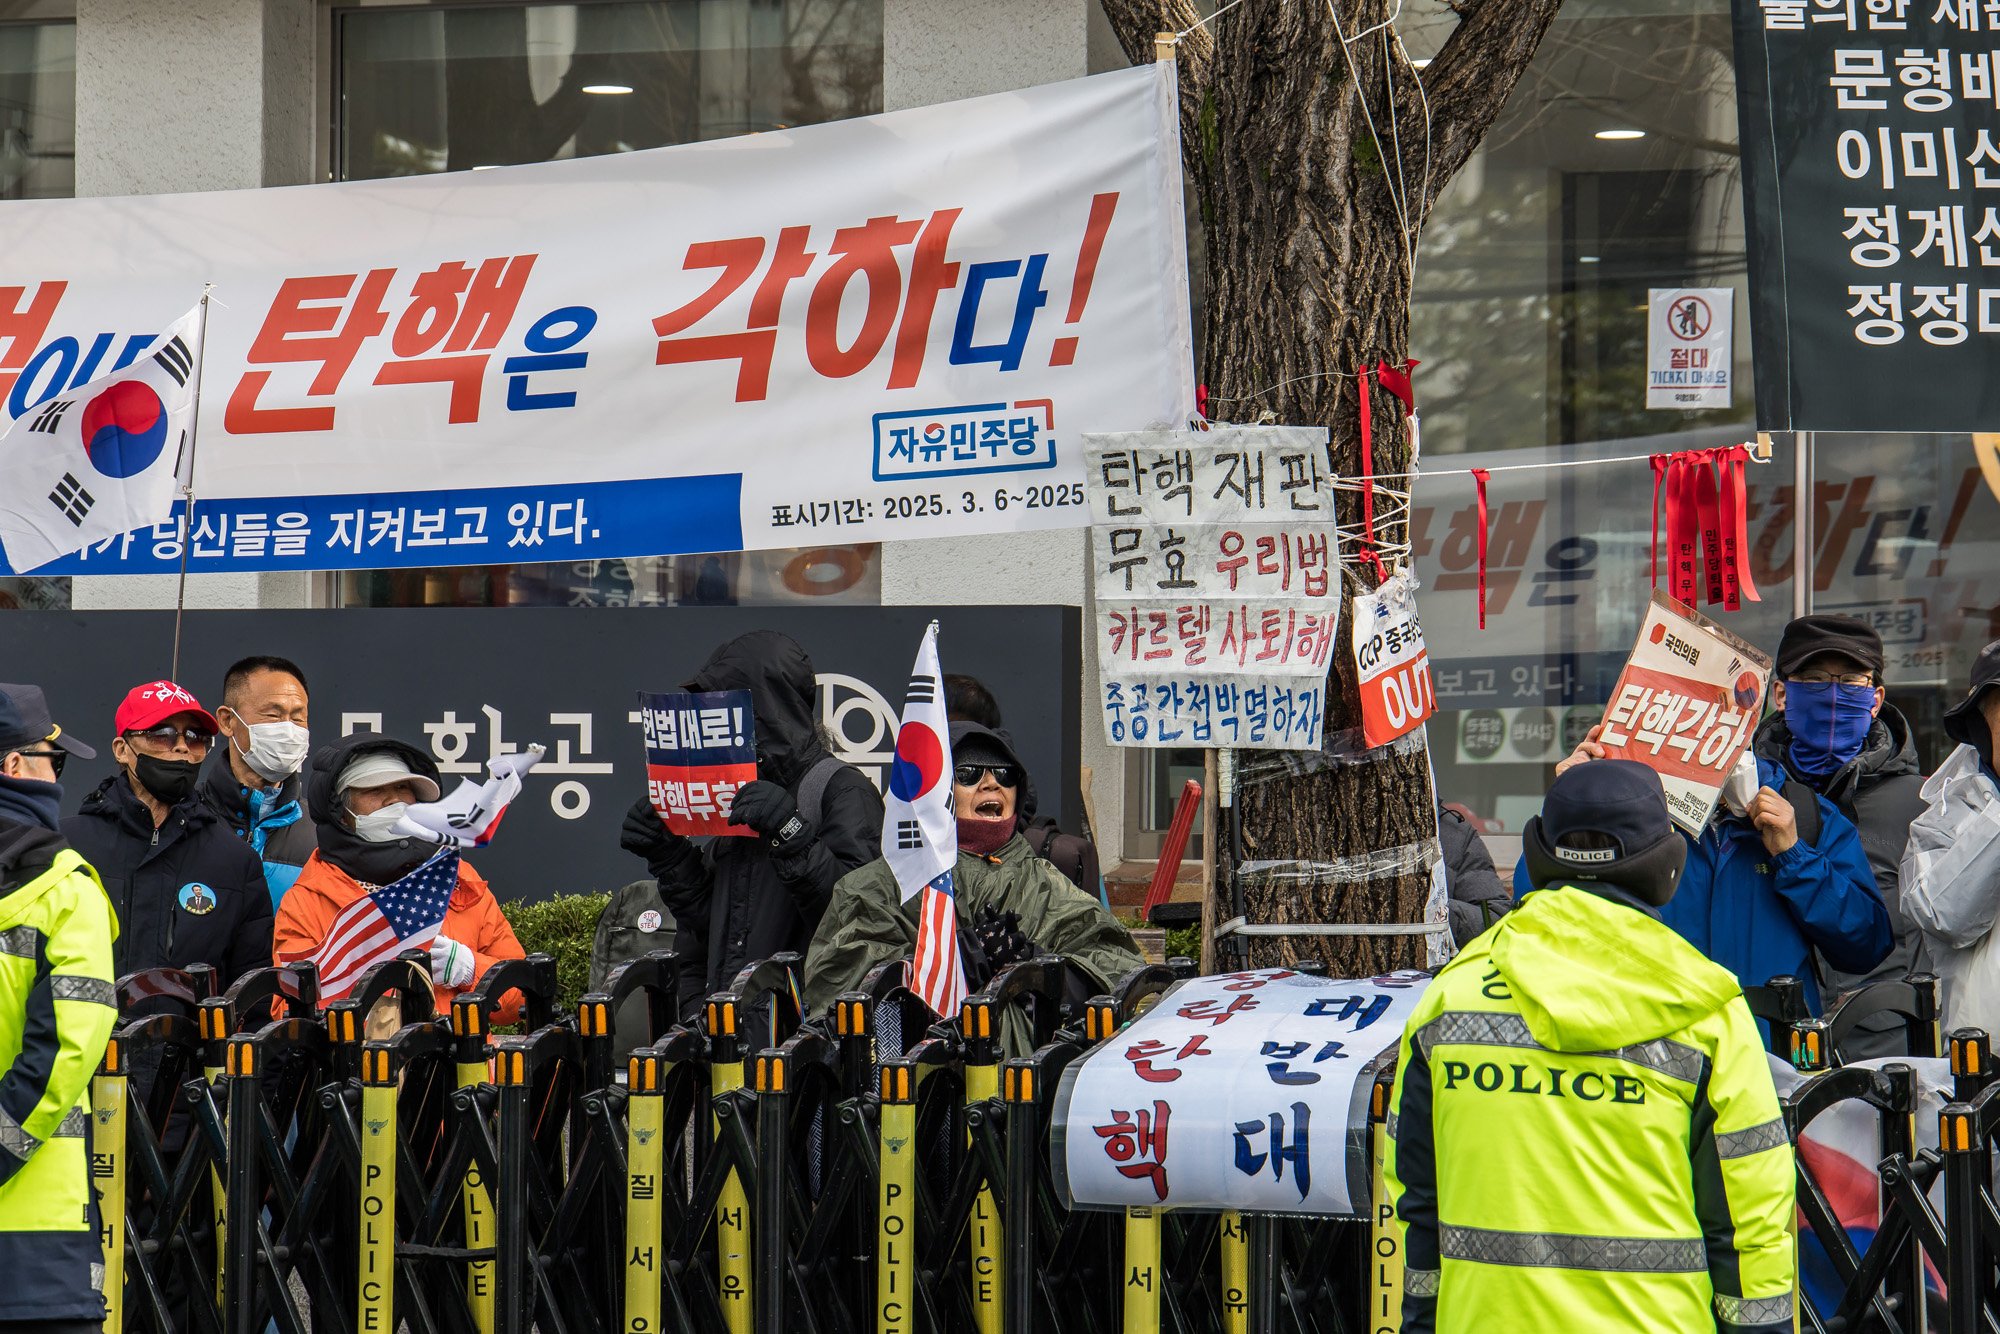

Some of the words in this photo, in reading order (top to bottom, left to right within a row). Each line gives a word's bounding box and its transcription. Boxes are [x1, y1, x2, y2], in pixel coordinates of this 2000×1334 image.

[224, 253, 598, 435] 탄핵은
[652, 192, 1120, 403] 각하다!
[1650, 371, 1687, 384] 기대지
[1670, 348, 1708, 369] 절대
[888, 415, 1040, 463] 자유민주당
[152, 511, 311, 560] 당신들을
[326, 506, 488, 556] 지켜보고
[507, 499, 601, 547] 있다.
[771, 499, 874, 528] 표시기간:
[883, 493, 953, 519] 2025.
[961, 491, 984, 514] 3.
[1108, 528, 1198, 591] 무효
[1216, 528, 1328, 598] 우리법
[1109, 605, 1210, 667] 카르텔
[1219, 604, 1335, 668] 사퇴해
[1359, 634, 1383, 671] CCP
[1664, 632, 1701, 667] 국민의힘
[1381, 654, 1432, 730] OUT
[1510, 664, 1584, 698] 있다.
[642, 706, 745, 750] 헌법대로!
[1599, 683, 1753, 771] 탄핵각하
[1563, 849, 1612, 860] POLICE
[1442, 1061, 1645, 1105] POLICE
[363, 1165, 383, 1330] POLICE
